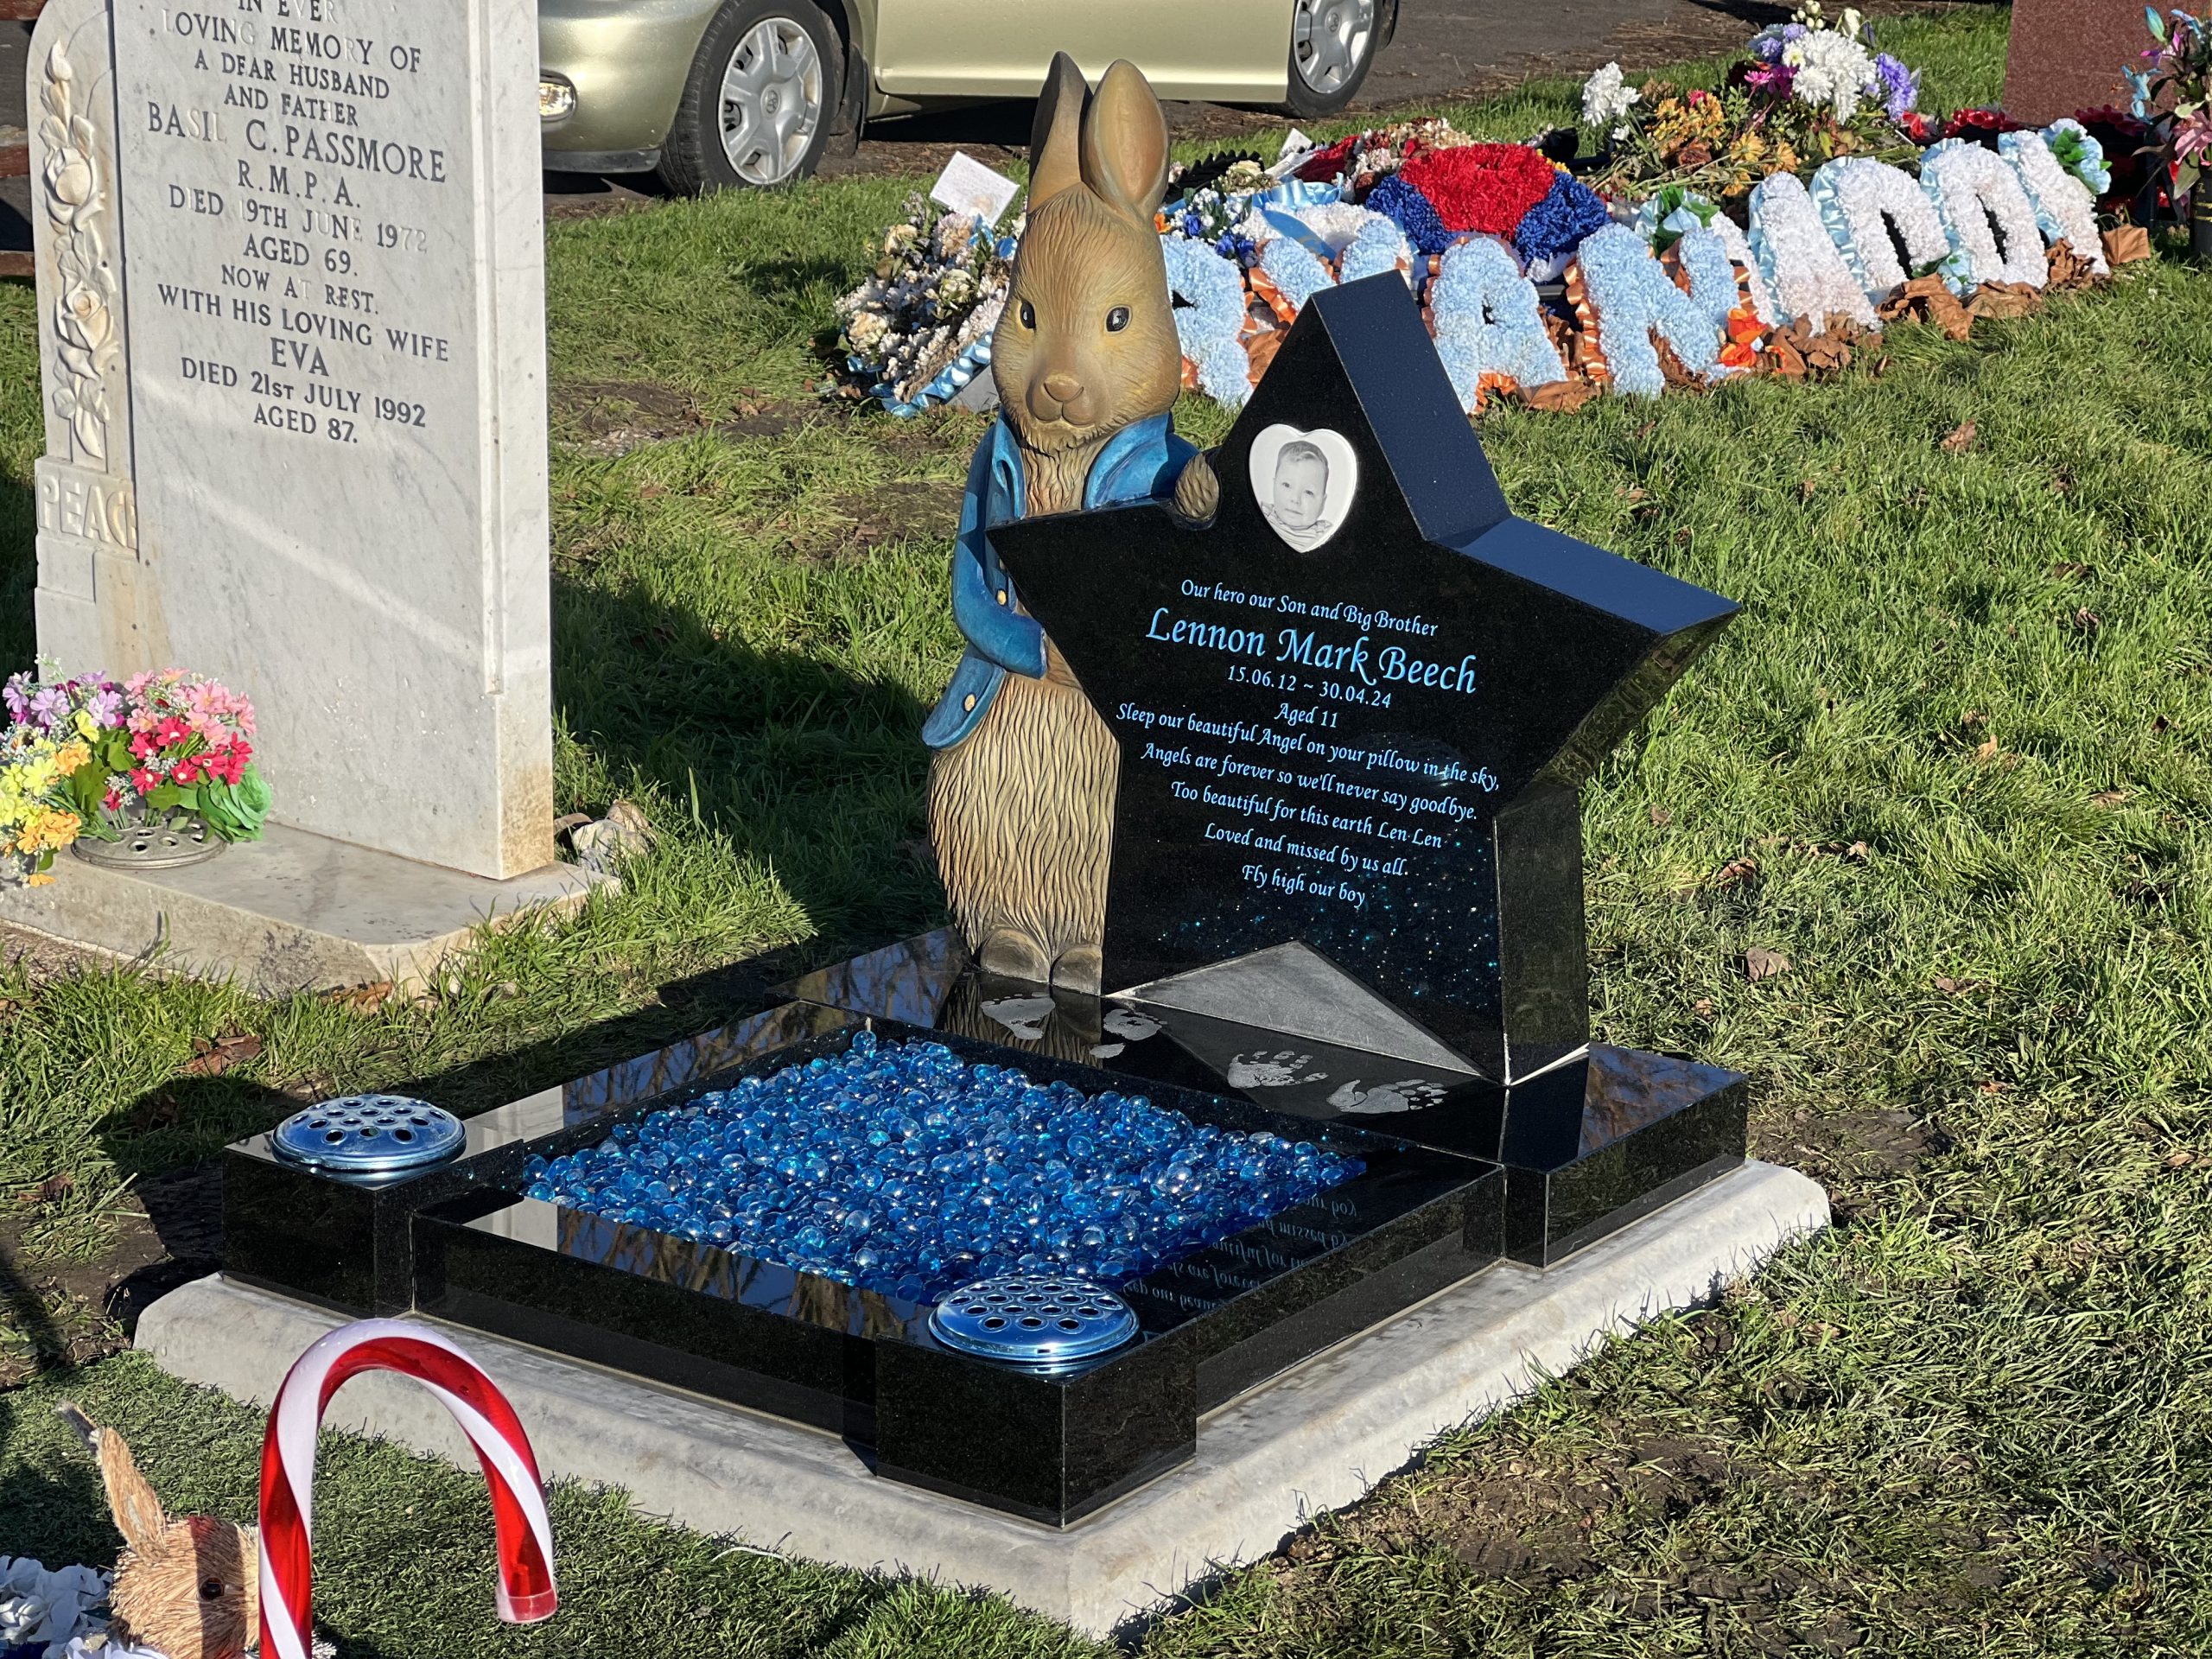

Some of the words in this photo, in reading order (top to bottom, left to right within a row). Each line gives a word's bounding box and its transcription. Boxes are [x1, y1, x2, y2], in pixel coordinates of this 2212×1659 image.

[162, 9, 255, 44] LOVING
[270, 26, 373, 65] MEMORY
[390, 45, 421, 73] OF
[194, 48, 209, 70] A
[221, 52, 276, 81] DEAR
[289, 63, 390, 99] HUSBAND
[148, 101, 227, 143] BASIL
[224, 84, 268, 110] AND
[281, 93, 359, 127] FATHER
[168, 184, 223, 216] DIED
[239, 198, 288, 229] 19TH
[302, 209, 363, 242] JUNE
[377, 222, 428, 254] 1972
[243, 232, 309, 266] AGED
[324, 248, 358, 276] 69.
[221, 264, 270, 292] NOW
[283, 276, 312, 299] AT
[325, 283, 378, 315] REST.
[157, 283, 221, 317] WITH
[232, 298, 271, 327] HIS
[282, 308, 372, 346] LOVING
[386, 328, 448, 362] WIFE
[270, 337, 329, 377] EVA
[181, 357, 238, 387] DIED
[304, 383, 361, 414] JULY
[374, 397, 426, 428] 1992
[253, 403, 316, 435] AGED
[327, 418, 358, 443] 87.
[1181, 579, 1210, 598] Our
[1214, 582, 1244, 604] hero
[1249, 594, 1275, 608] our
[1277, 595, 1306, 614] Son
[1311, 602, 1343, 620] and
[1344, 605, 1371, 631] Big
[1375, 610, 1439, 637] Brother
[1146, 607, 1266, 657] Lennon
[1276, 628, 1376, 685] Mark
[1379, 646, 1477, 694] Beech
[1228, 665, 1296, 691] 15.06.12
[1319, 681, 1392, 708] 30.04.24
[1274, 703, 1319, 726] Aged
[1320, 711, 1338, 728] 11
[1116, 702, 1154, 728] Sleep
[1159, 715, 1184, 728] our
[1188, 713, 1258, 743] beautiful
[1256, 728, 1306, 754] Angel
[1306, 741, 1325, 755] on
[1327, 745, 1365, 762] your
[1366, 749, 1420, 770] pillow
[1423, 759, 1439, 776] in
[1443, 761, 1467, 781] the
[1141, 742, 1191, 766] Angels
[1195, 755, 1217, 770] are
[1217, 754, 1274, 780] forever
[1277, 772, 1293, 785] so
[1297, 773, 1336, 792] we'll
[1336, 782, 1380, 800] never
[1382, 791, 1408, 811] say
[1409, 796, 1477, 823] goodbye.
[1171, 781, 1198, 800] Too
[1203, 785, 1274, 817] beautiful
[1269, 799, 1297, 822] for
[1300, 805, 1329, 827] this
[1332, 816, 1373, 836] earth
[1377, 822, 1407, 842] Len
[1412, 828, 1442, 849] Len
[1205, 823, 1254, 846] Loved
[1255, 835, 1287, 852] and
[1287, 842, 1339, 863] missed
[1340, 848, 1358, 872] by
[1362, 857, 1380, 871] us
[1242, 864, 1268, 888] Fly
[1271, 868, 1306, 895] high
[1309, 882, 1336, 899] our
[1338, 882, 1365, 909] boy
